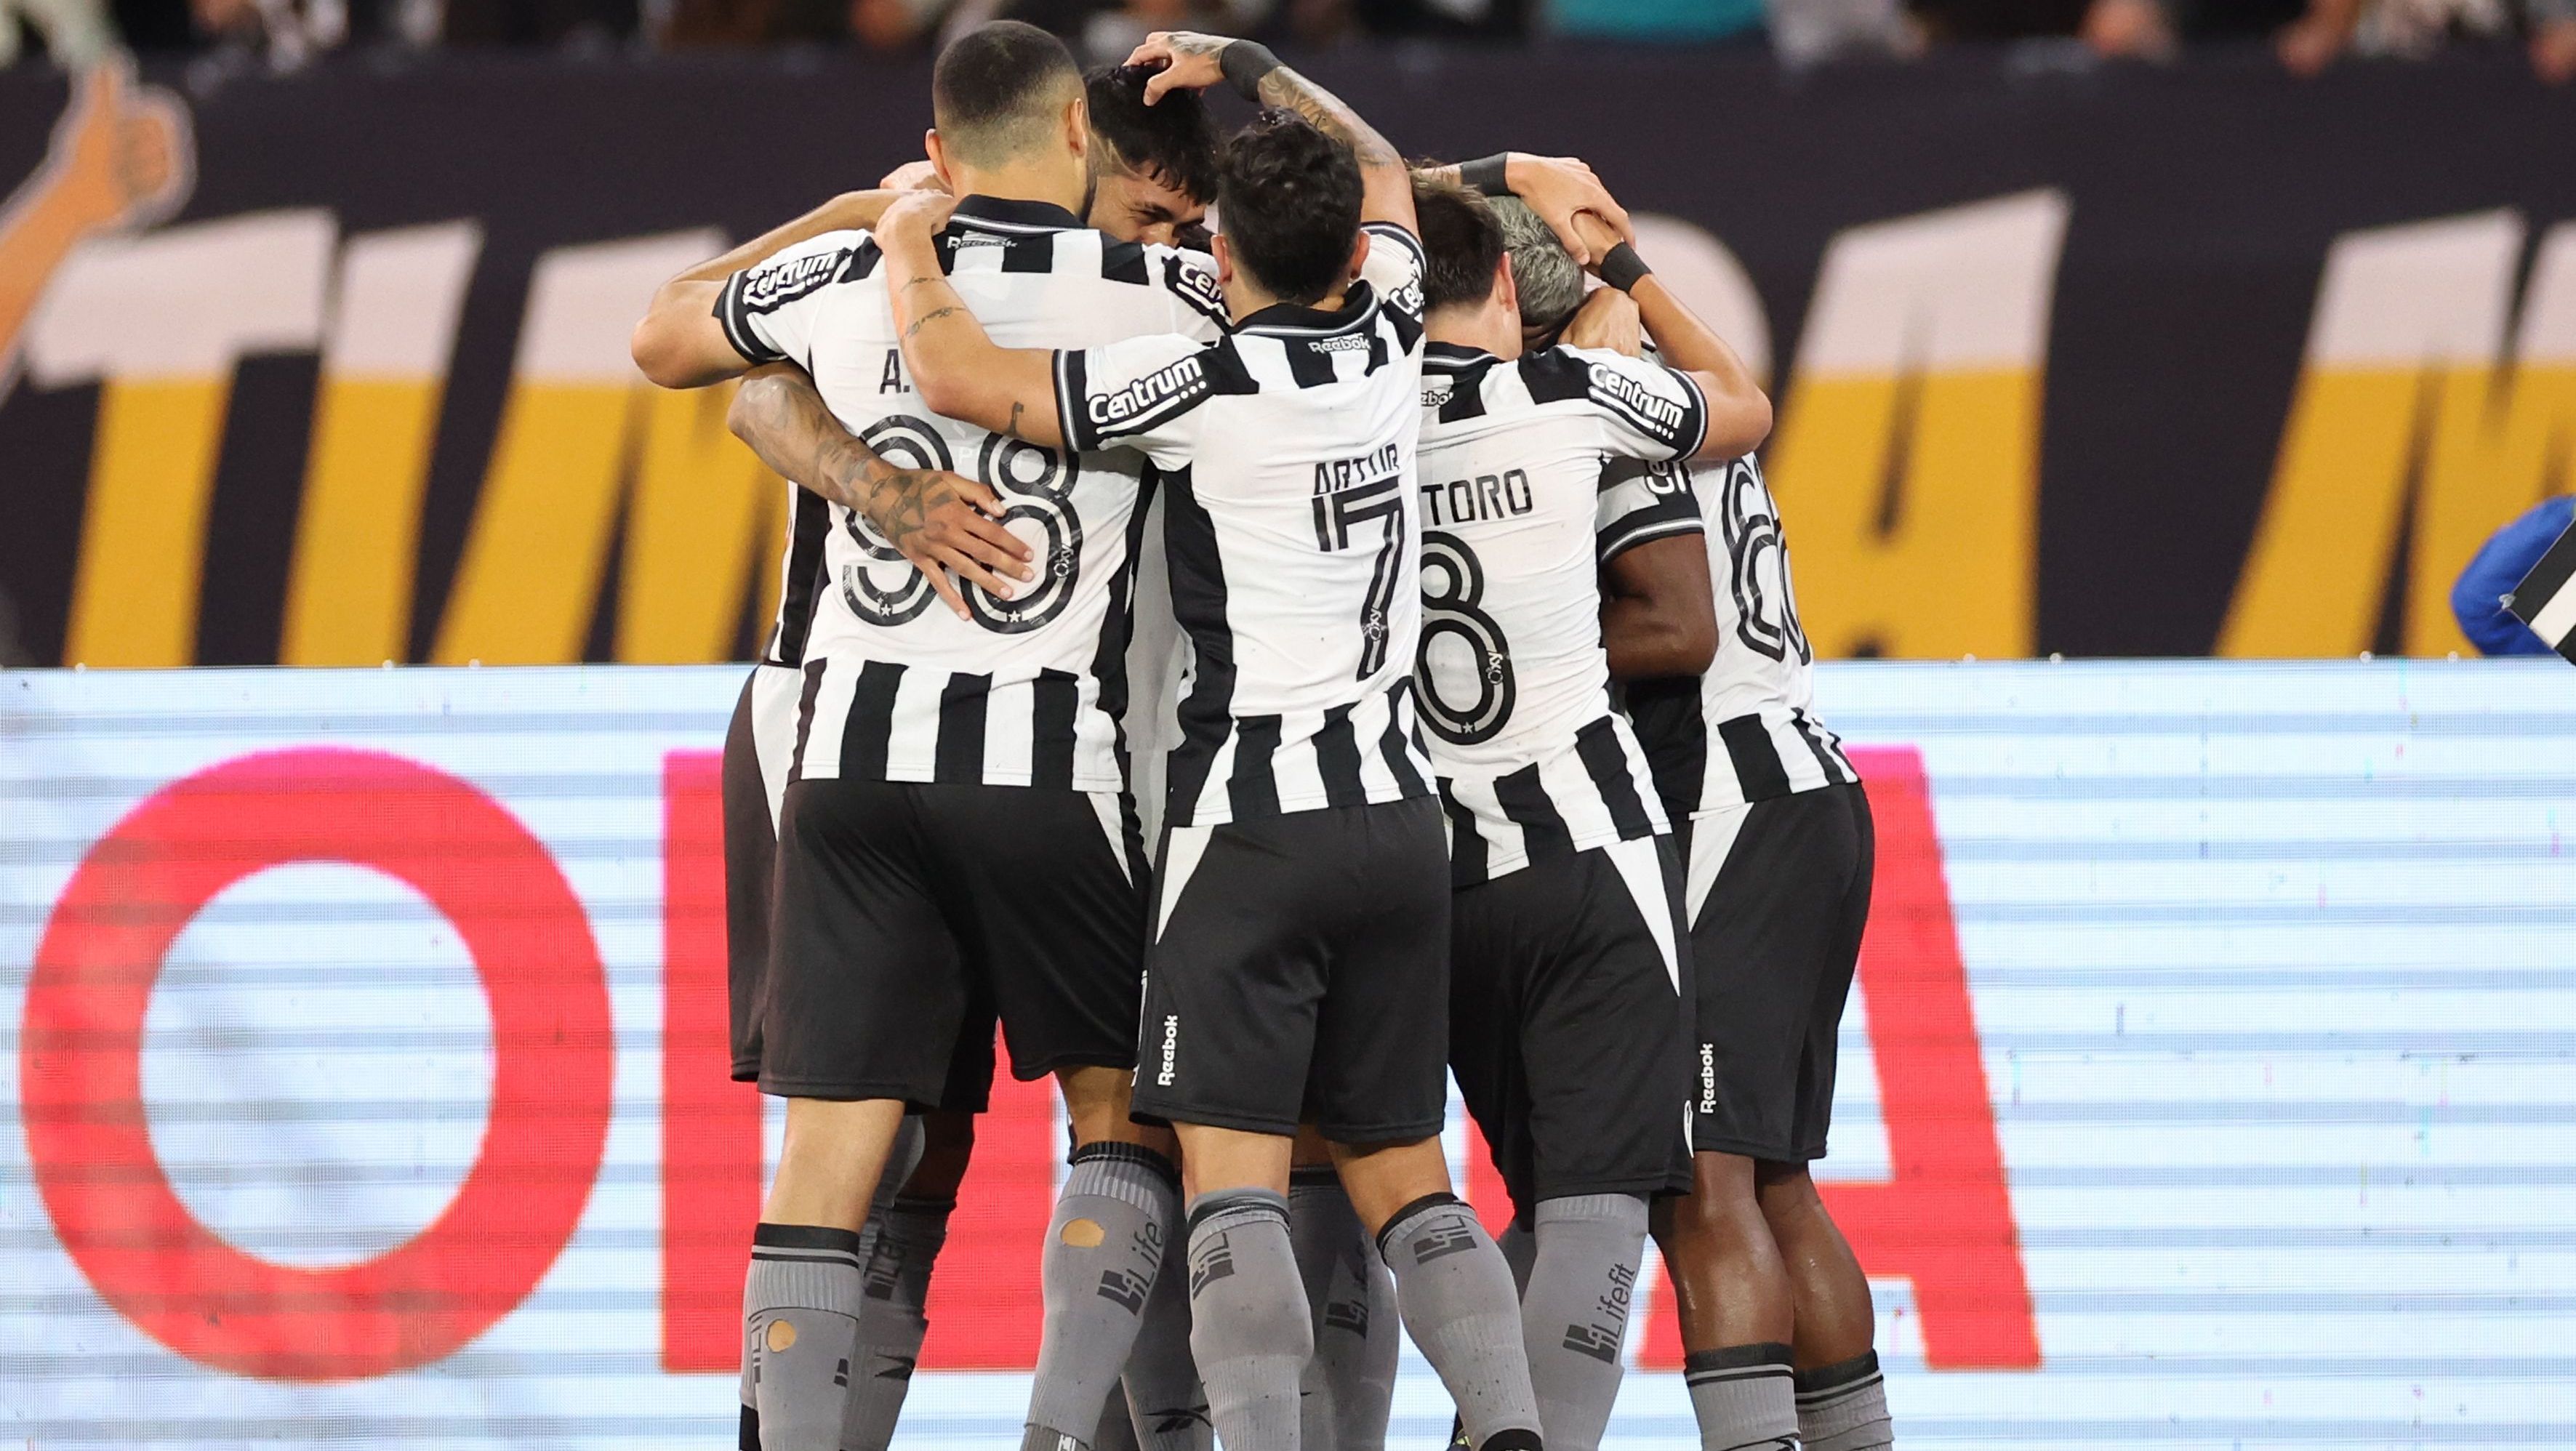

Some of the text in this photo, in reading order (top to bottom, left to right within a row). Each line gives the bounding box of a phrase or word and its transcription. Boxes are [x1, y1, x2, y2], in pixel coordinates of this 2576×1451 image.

[1309, 335, 1371, 354] Reebok
[1088, 356, 1203, 424] Centrum
[1588, 363, 1684, 429] Centrum
[1421, 468, 1533, 526] TORO
[1312, 474, 1405, 683] 17
[1413, 530, 1517, 746] 8
[1157, 1014, 1179, 1087] Reebok
[1700, 1042, 1717, 1114] Reebok
